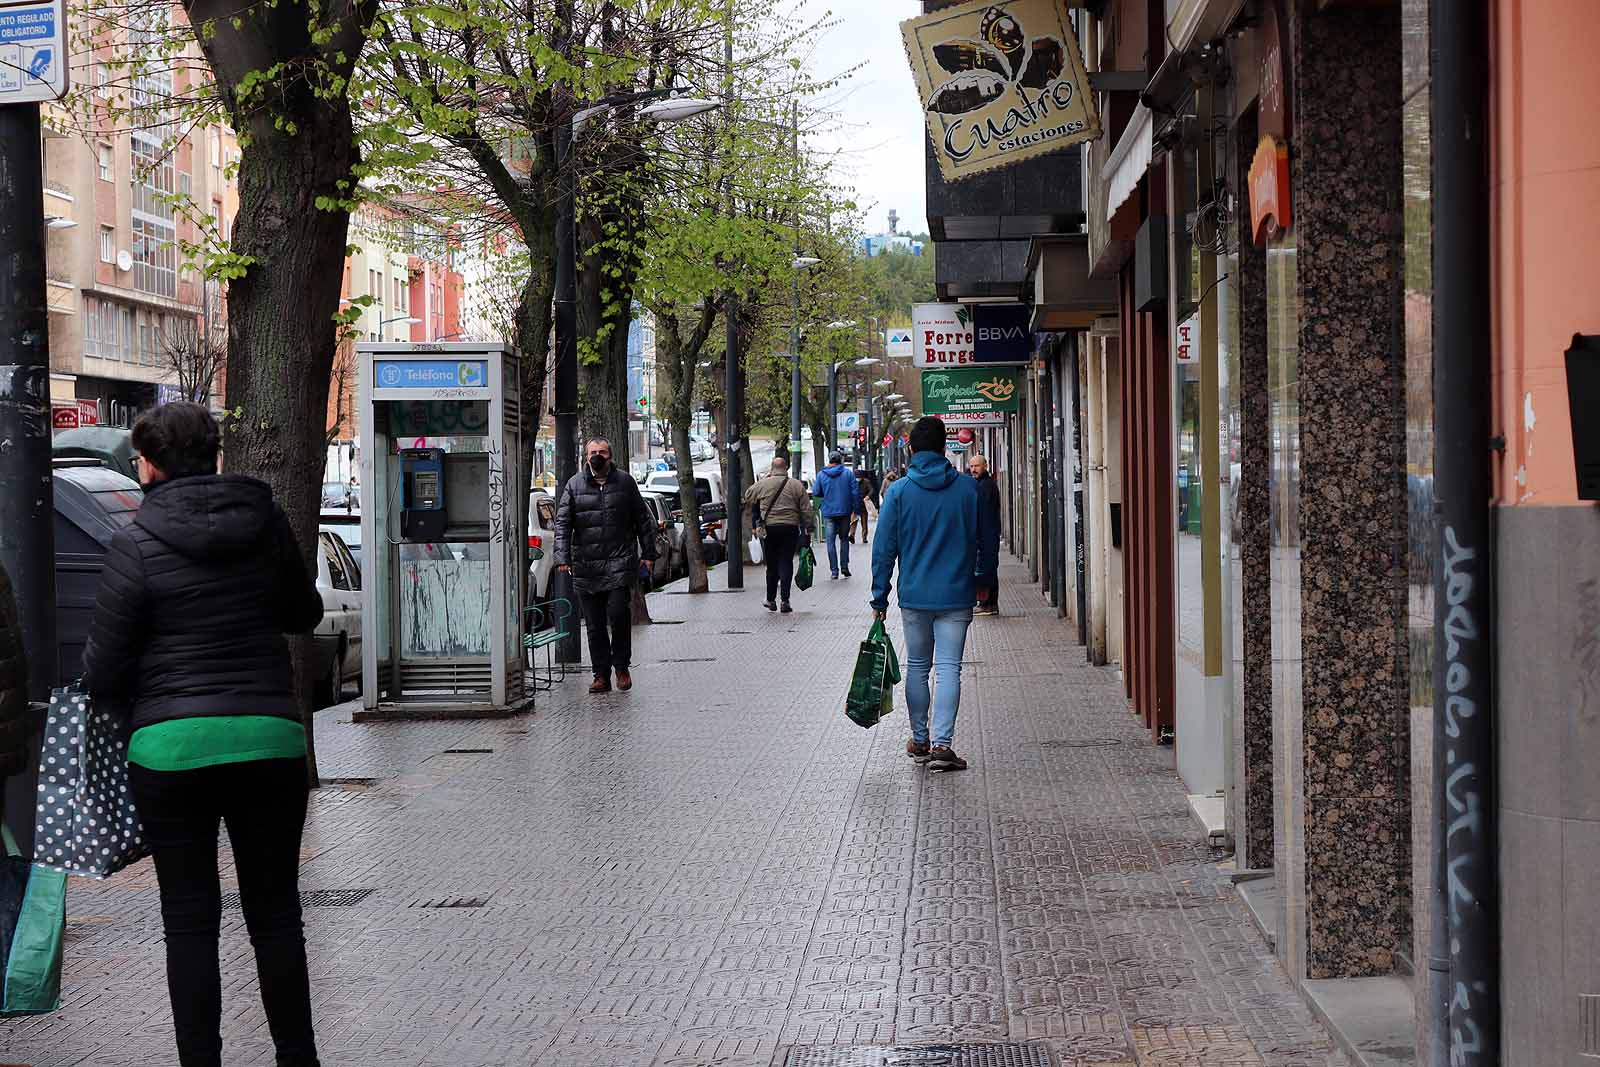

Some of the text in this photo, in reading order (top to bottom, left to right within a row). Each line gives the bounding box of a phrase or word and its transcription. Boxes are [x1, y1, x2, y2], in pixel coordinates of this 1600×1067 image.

[17, 13, 54, 24] REGULADO
[1, 26, 47, 37] OBLIGATORIO
[944, 80, 1073, 159] Cuatro
[998, 118, 1085, 151] estaciones
[924, 330, 973, 346] Ferre
[978, 327, 1025, 341] BBVA
[404, 369, 454, 381] Teléfono
[976, 377, 1015, 402] Zoo
